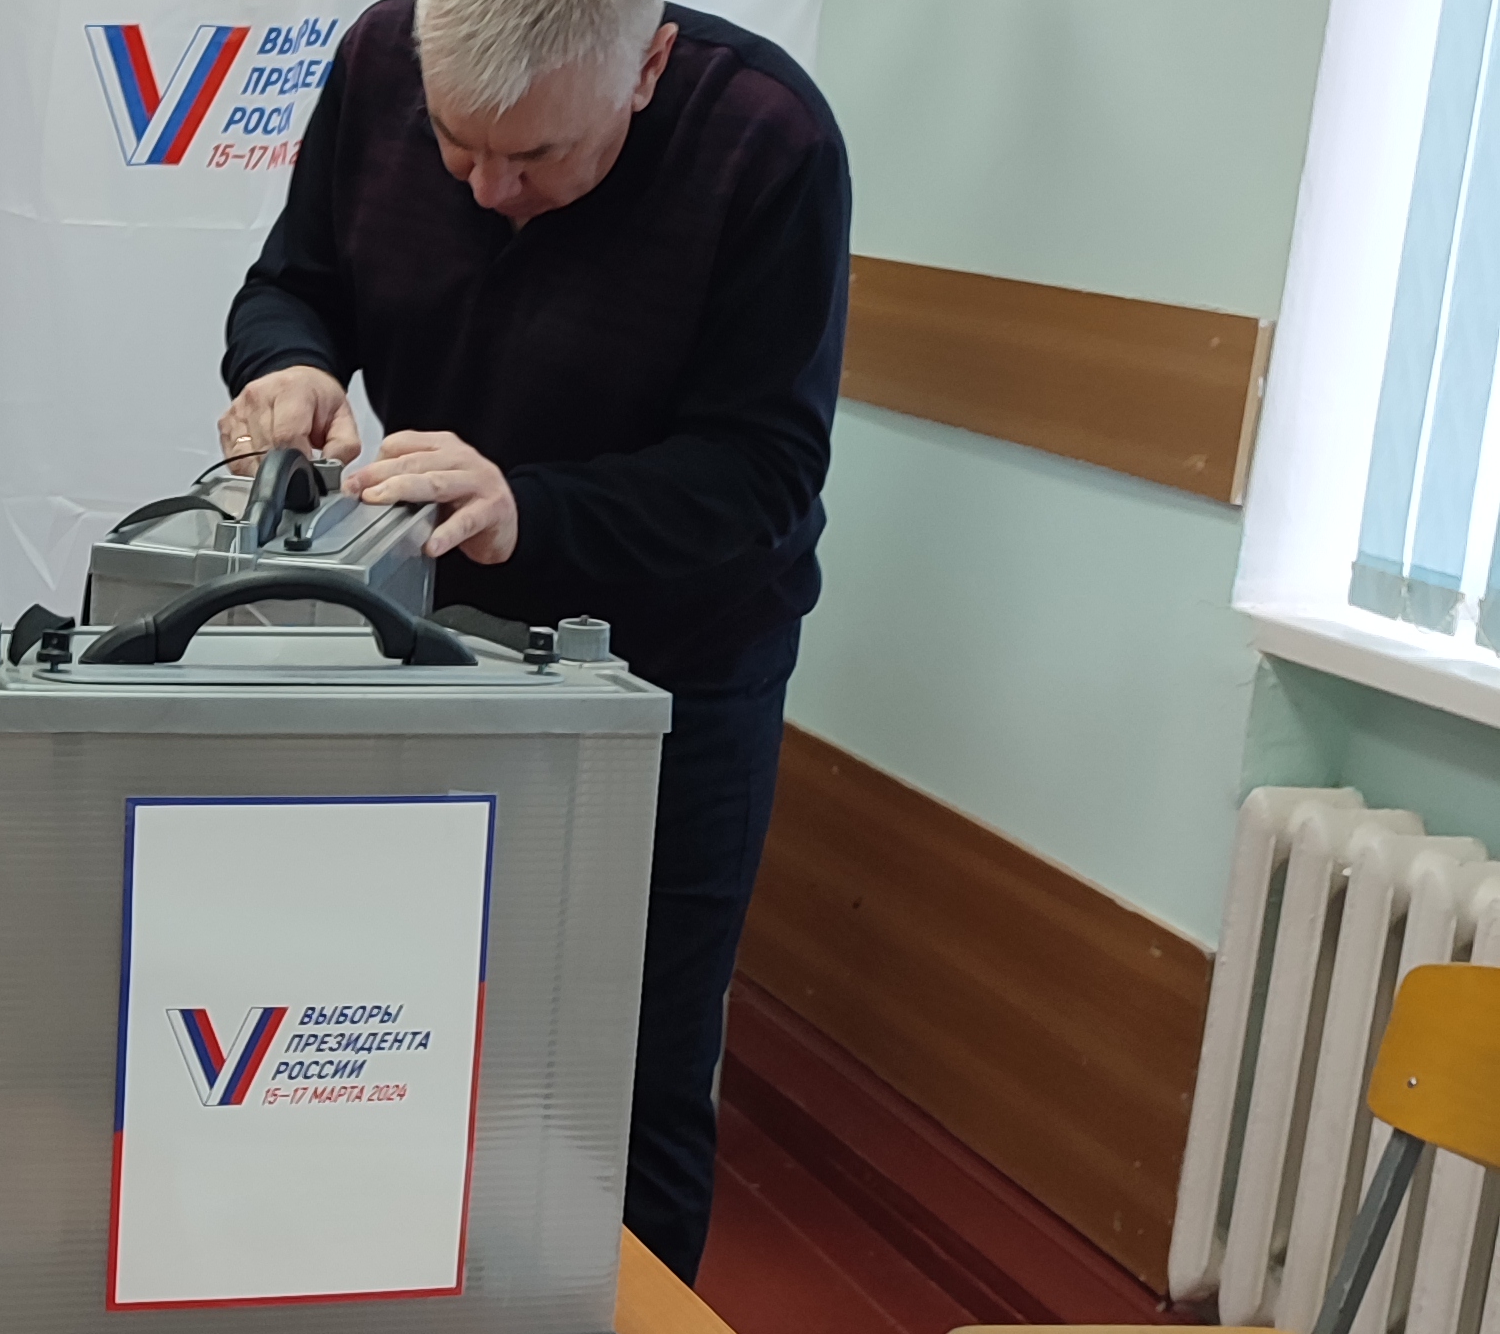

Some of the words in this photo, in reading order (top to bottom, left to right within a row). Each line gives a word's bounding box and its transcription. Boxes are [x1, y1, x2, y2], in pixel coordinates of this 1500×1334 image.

[298, 1004, 405, 1026] ВЫБОРЫ
[284, 1031, 431, 1054] ПРЕЗИДЕНТА
[271, 1059, 367, 1081] РОССИИ
[308, 1085, 365, 1104] МАРТА
[366, 1084, 407, 1102] 2024
